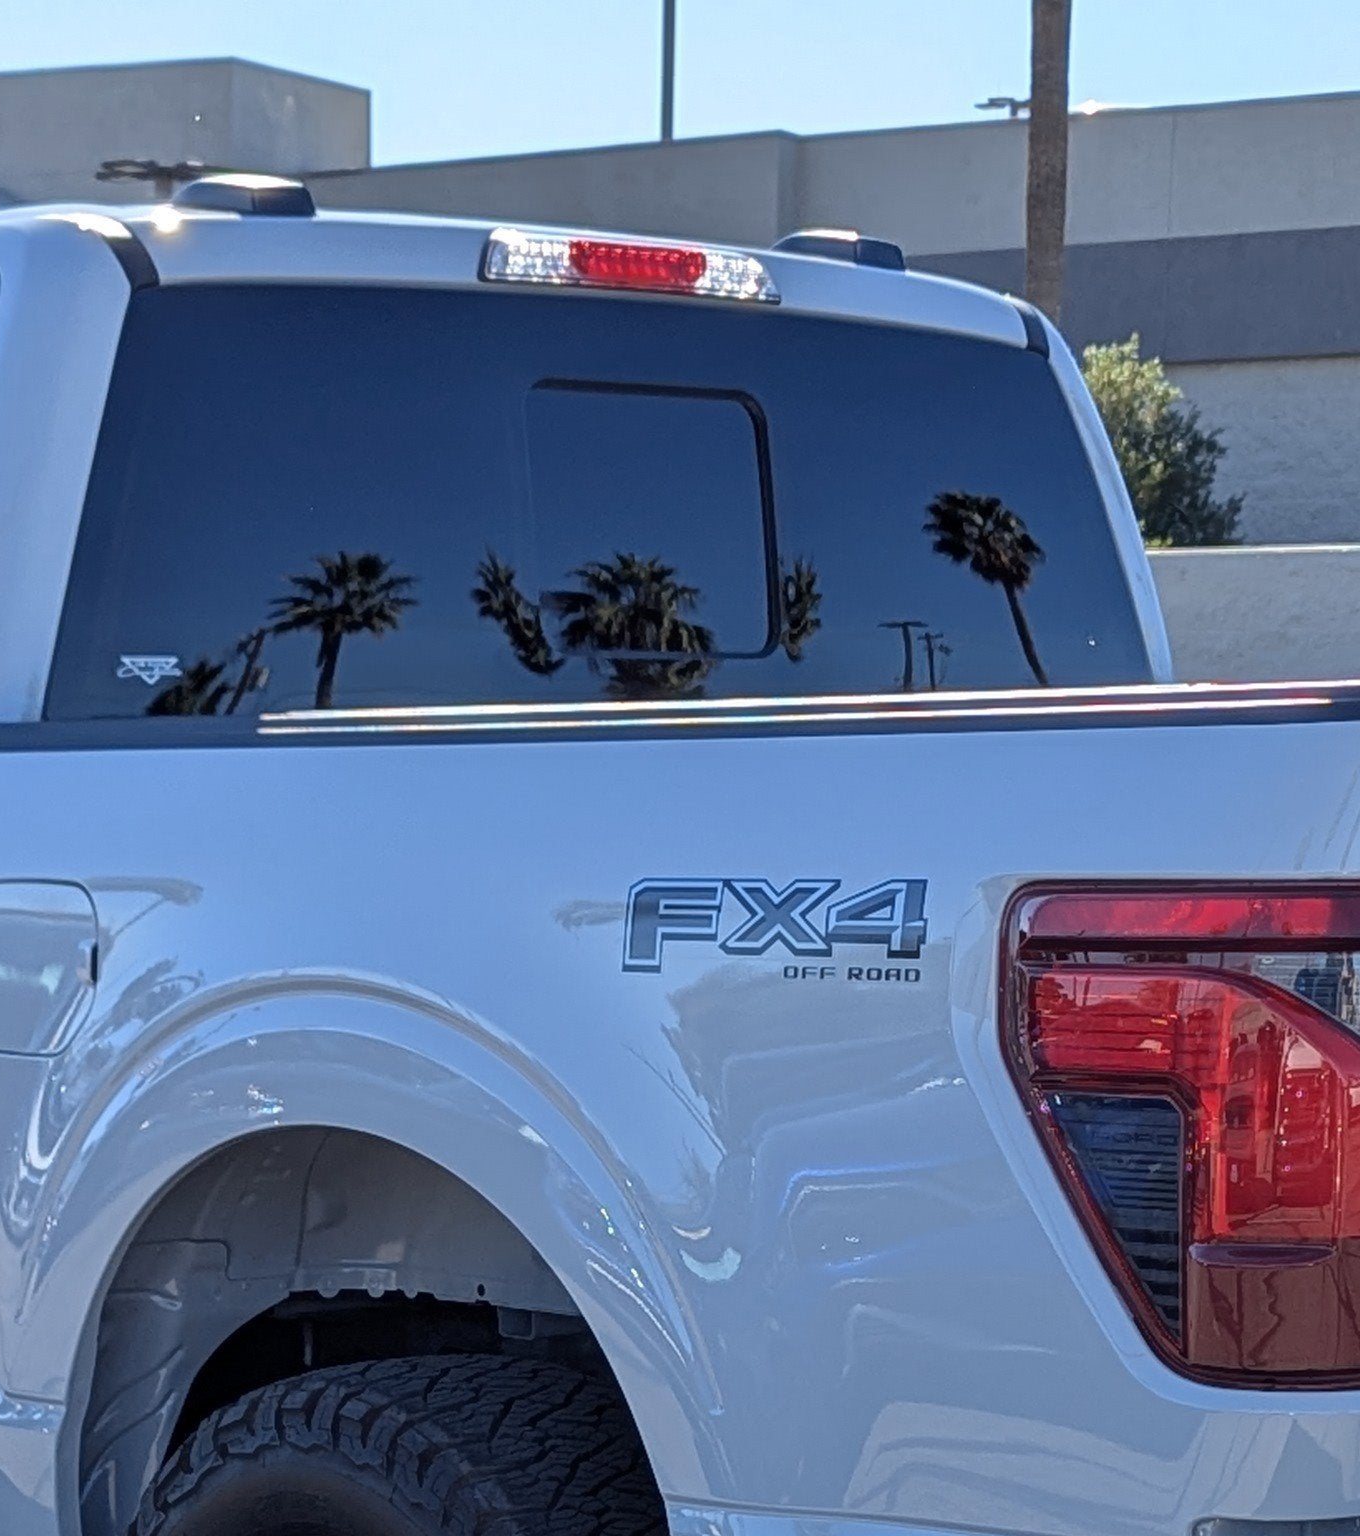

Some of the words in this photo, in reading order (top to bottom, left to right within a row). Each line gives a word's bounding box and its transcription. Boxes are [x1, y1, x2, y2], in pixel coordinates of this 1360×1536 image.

[621, 877, 929, 973] FX4
[783, 965, 836, 980] OFF
[847, 966, 921, 982] ROAD
